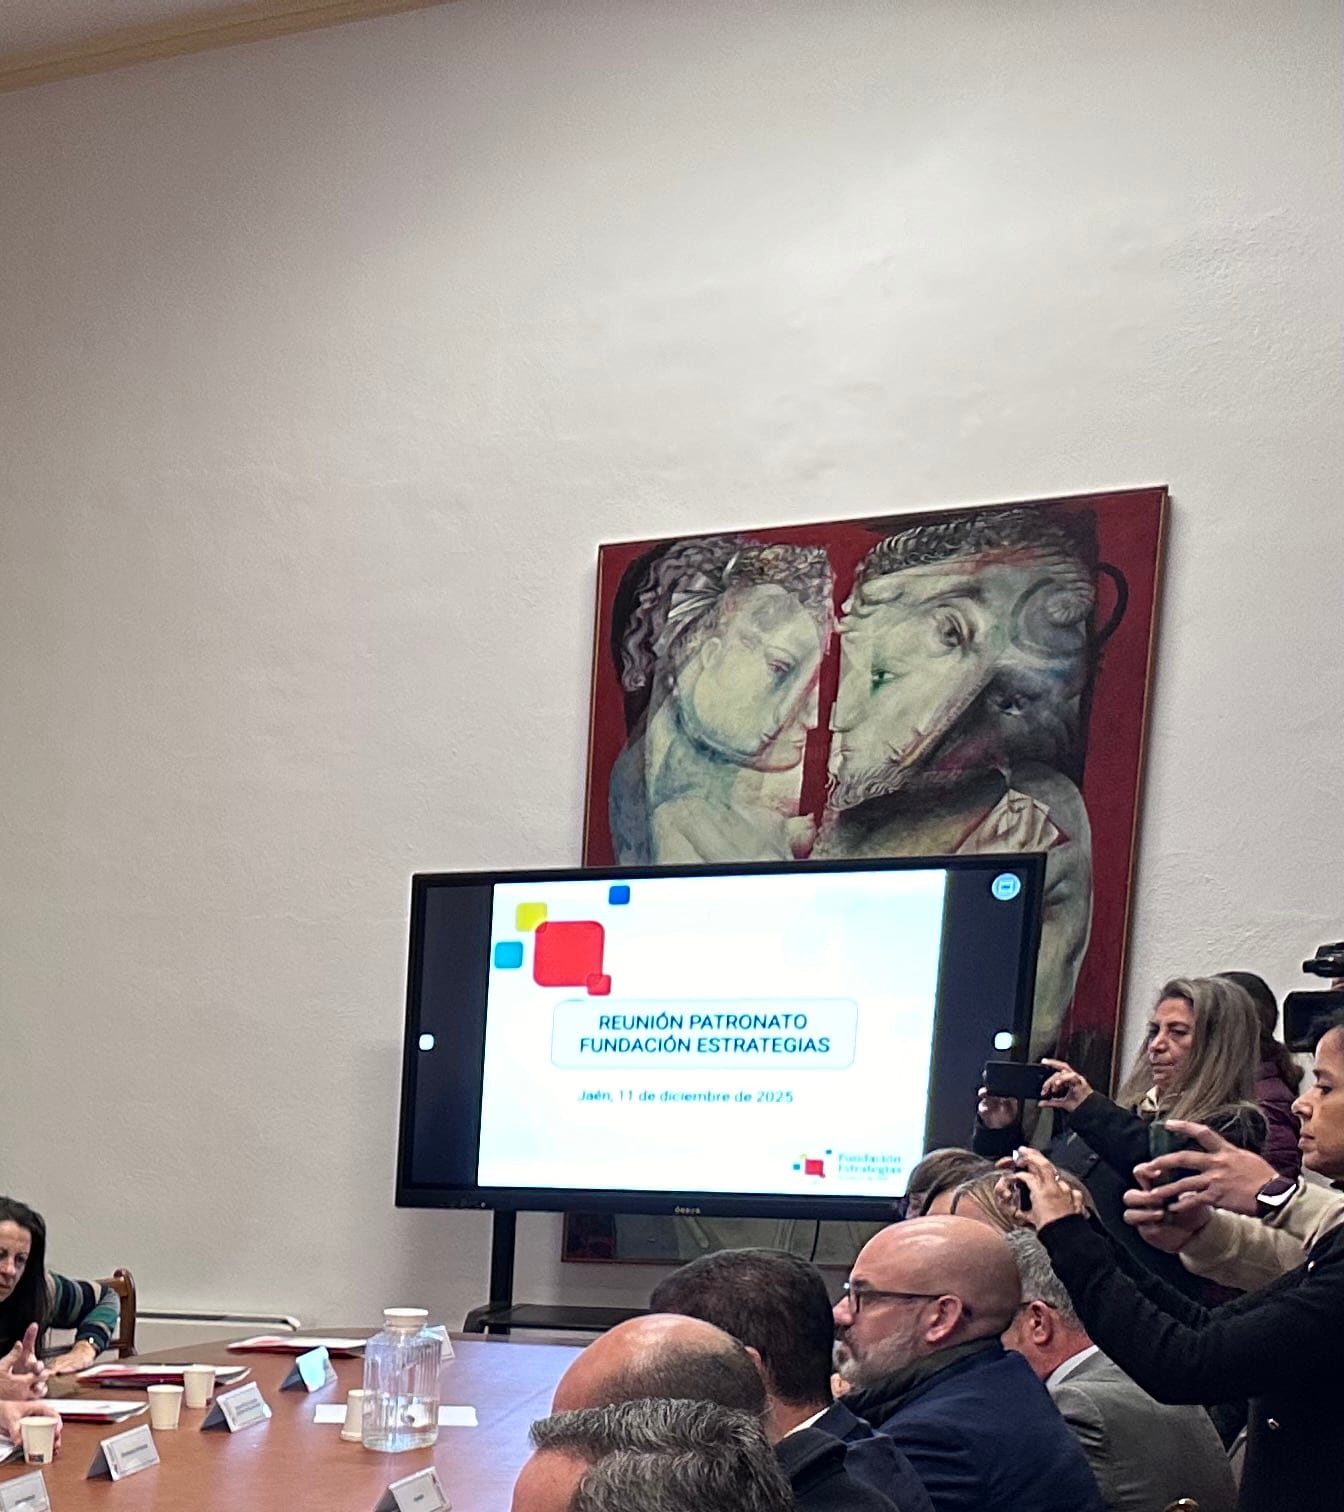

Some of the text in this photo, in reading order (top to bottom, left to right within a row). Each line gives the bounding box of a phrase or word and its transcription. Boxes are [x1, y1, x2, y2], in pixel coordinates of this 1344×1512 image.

[598, 1011, 808, 1031] REUNIÓN PATRONATO
[580, 1034, 831, 1054] FUNDACIÓN ESTRATEGIAS
[619, 1089, 633, 1102] 11
[639, 1089, 655, 1102] de
[660, 1090, 730, 1103] diciembre
[734, 1090, 752, 1103] de
[756, 1090, 794, 1103] 2025
